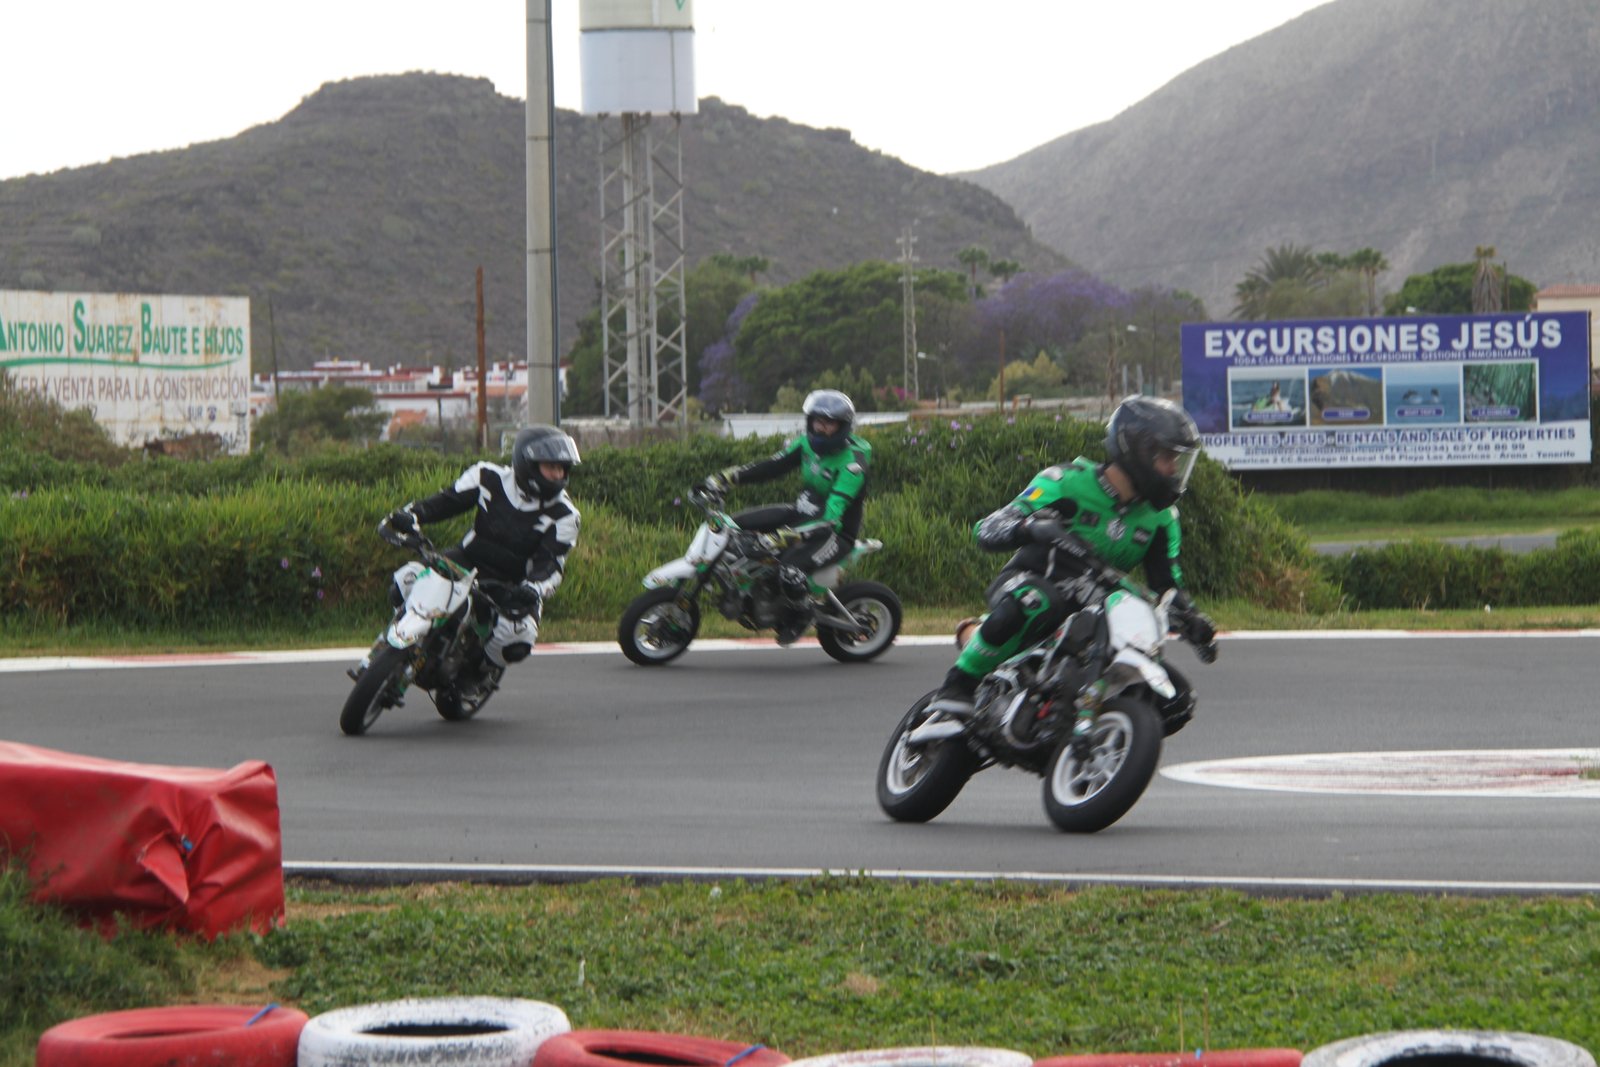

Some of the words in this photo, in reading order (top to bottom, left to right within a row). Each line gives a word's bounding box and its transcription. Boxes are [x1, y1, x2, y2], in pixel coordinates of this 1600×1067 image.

[73, 299, 133, 354] SUAREZ
[141, 302, 187, 354] BAUTE
[191, 326, 200, 355] E
[204, 326, 243, 355] HIJOS
[1204, 323, 1441, 358] EXCURSIONES
[1452, 315, 1562, 350] JESÚS
[54, 376, 95, 401] VENTA
[97, 377, 131, 401] PARA
[135, 377, 151, 401] LA
[1400, 430, 1428, 443] AND
[1432, 429, 1466, 442] SALE
[1469, 429, 1486, 442] OF
[1492, 427, 1576, 442] PROPERTIES
